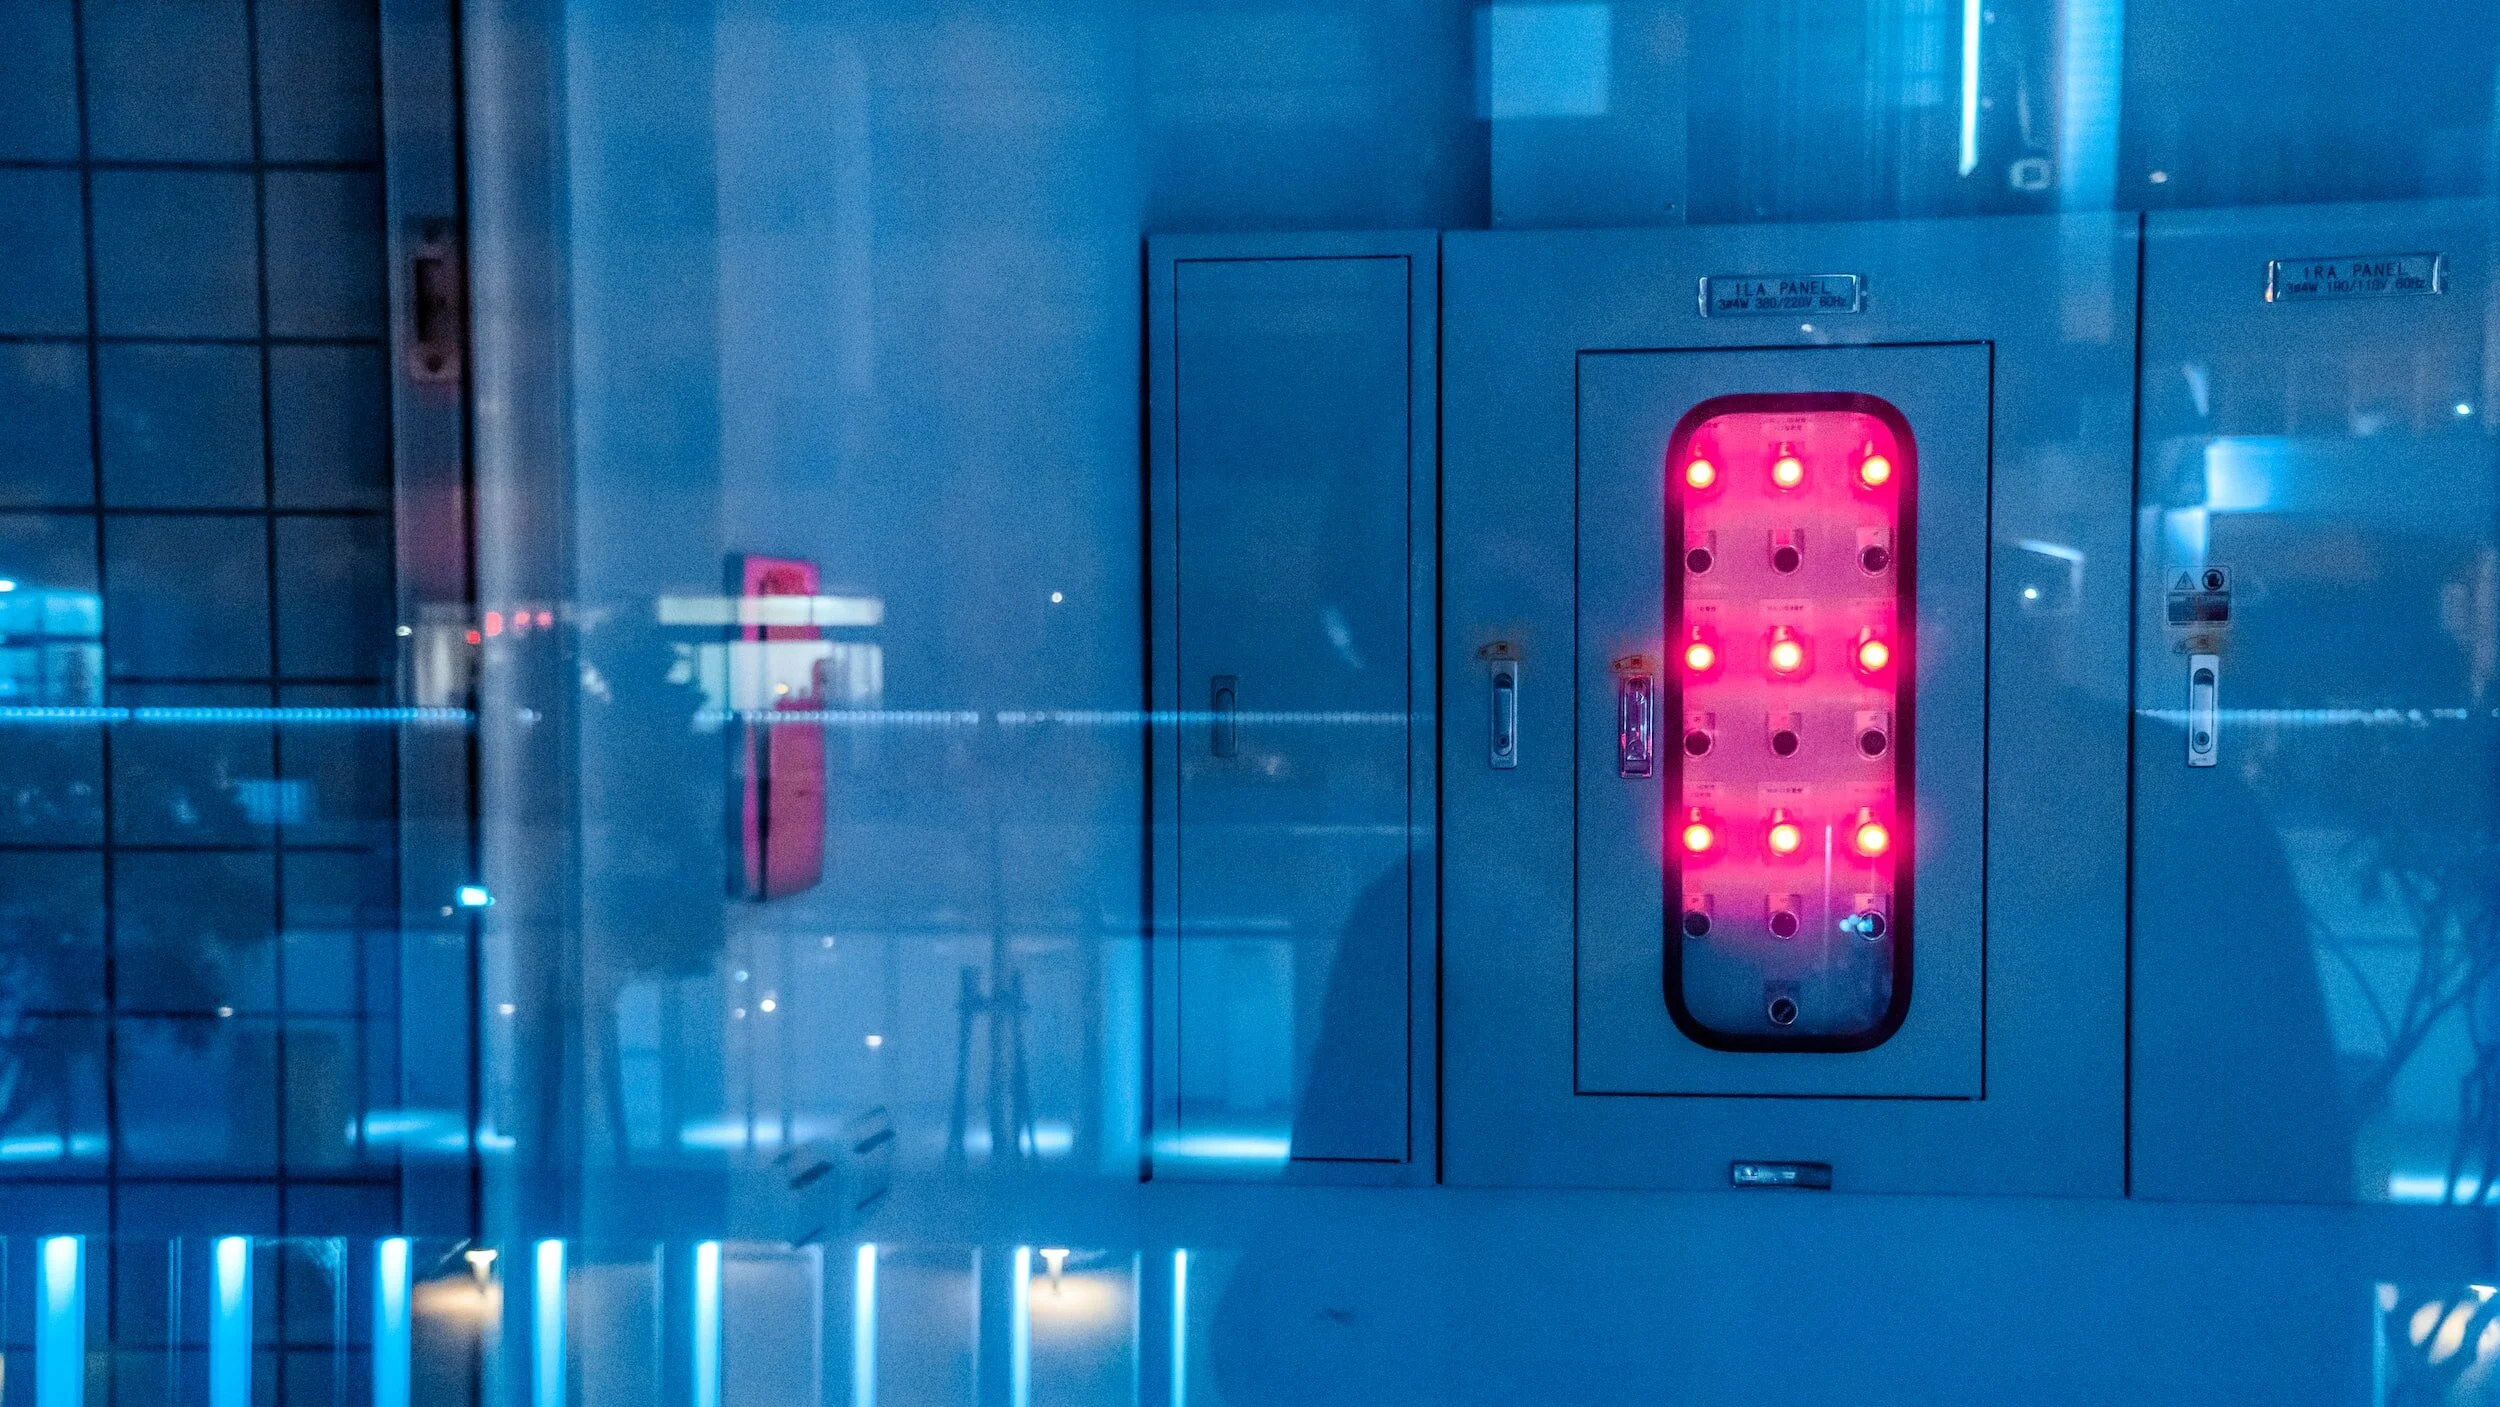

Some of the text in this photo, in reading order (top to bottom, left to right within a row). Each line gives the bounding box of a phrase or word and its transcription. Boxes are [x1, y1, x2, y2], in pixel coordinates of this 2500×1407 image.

[2353, 262, 2407, 277] PANEL
[1780, 280, 1829, 296] PANEL
[1755, 297, 1812, 309] 380/220V
[1819, 295, 1845, 308] 60Hz
